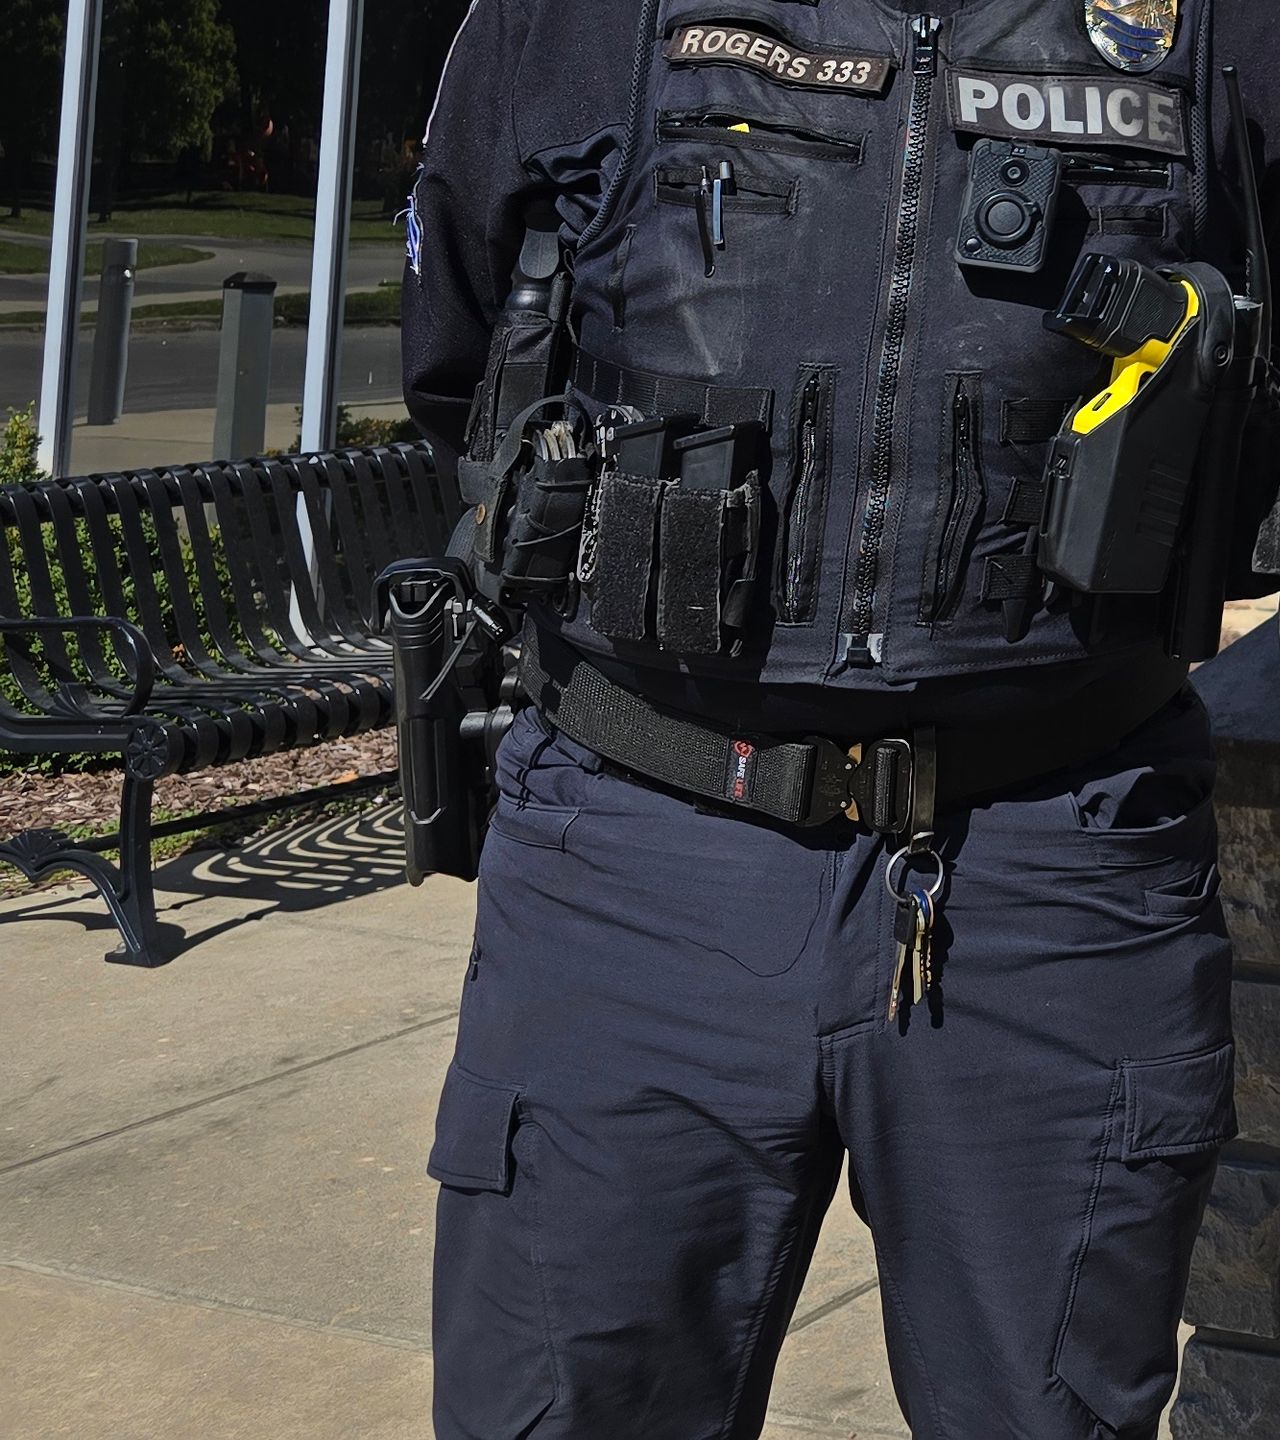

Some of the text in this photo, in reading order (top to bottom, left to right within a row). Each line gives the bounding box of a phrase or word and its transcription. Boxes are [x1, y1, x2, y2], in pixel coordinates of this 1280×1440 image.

[680, 28, 872, 85] ROGERS 333
[957, 76, 1177, 142] POLICE
